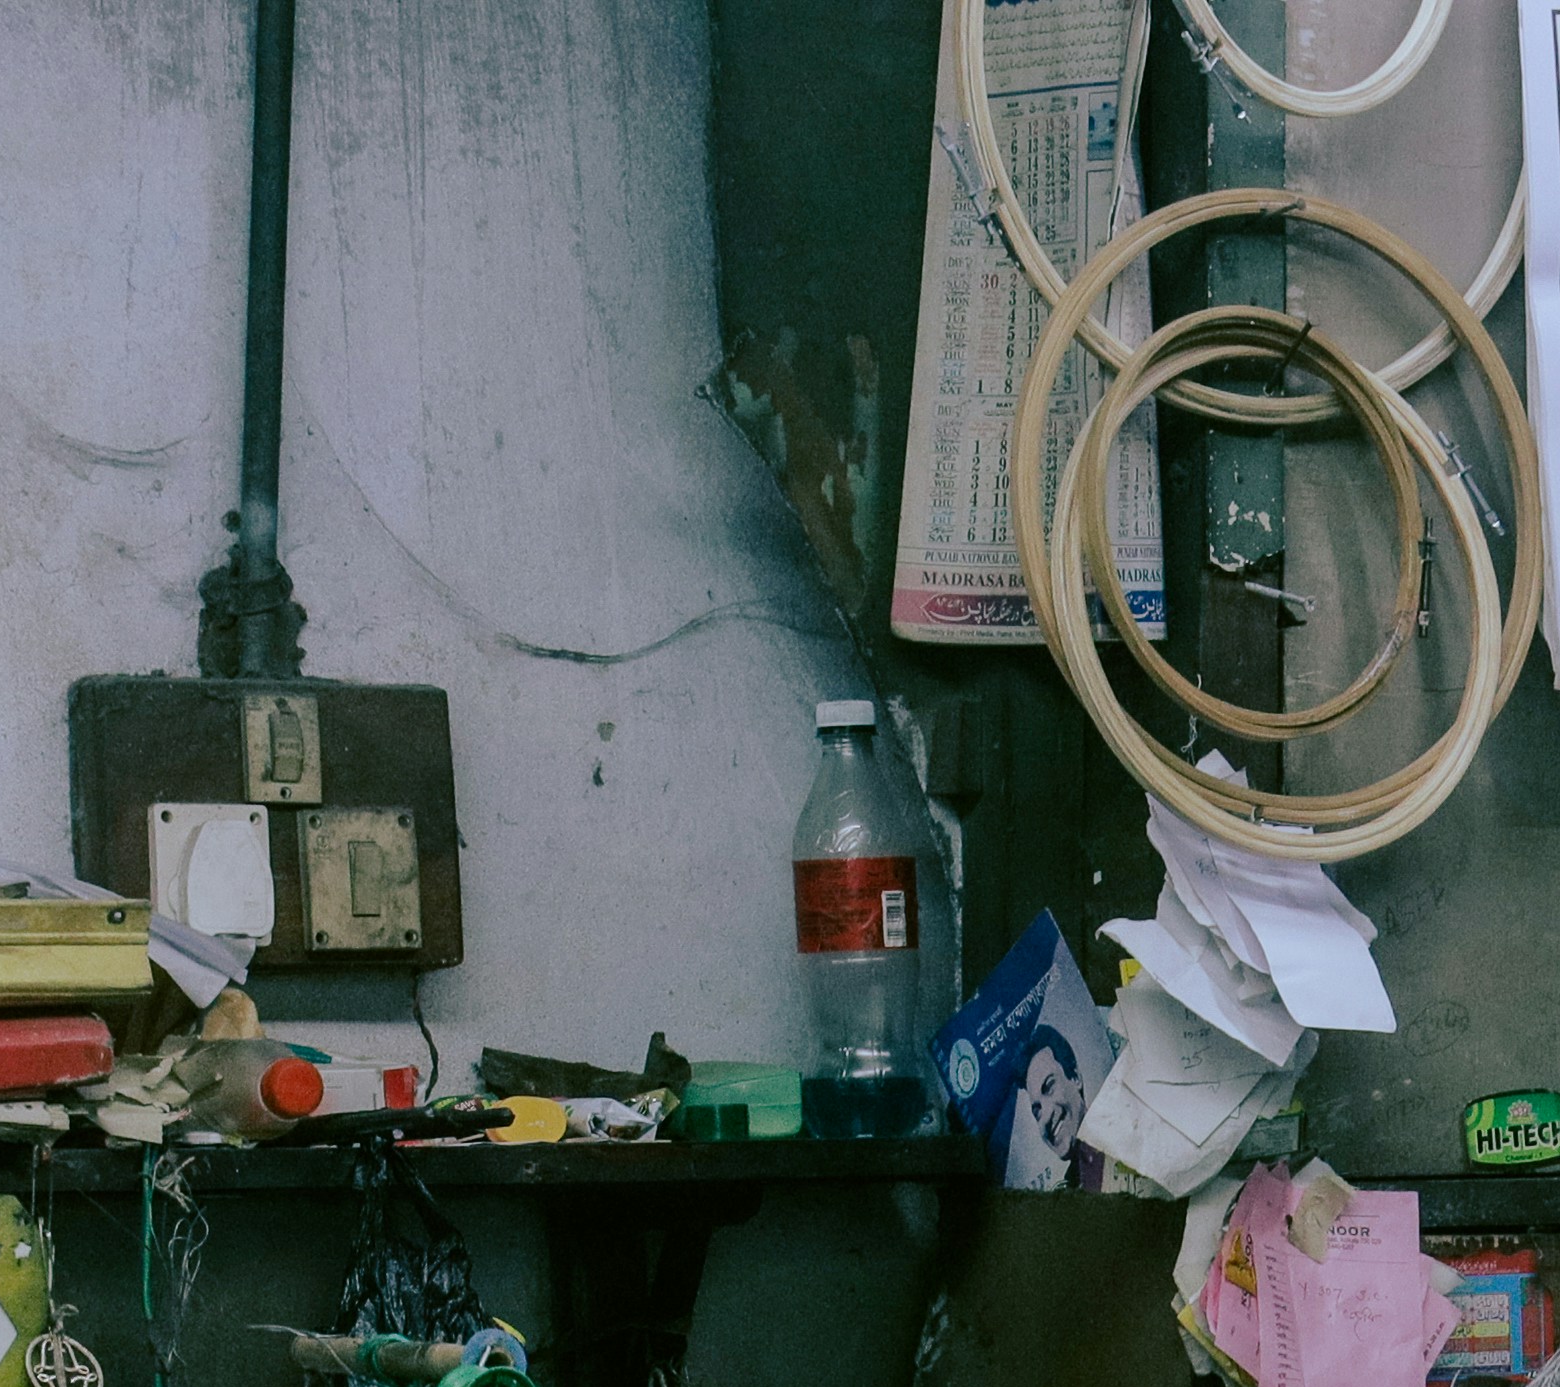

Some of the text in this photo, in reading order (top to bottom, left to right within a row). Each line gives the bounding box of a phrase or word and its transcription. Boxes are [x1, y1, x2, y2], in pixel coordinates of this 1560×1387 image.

[980, 274, 999, 289] 30
[994, 475, 1010, 490] 10
[921, 571, 1004, 588] MADRASA
